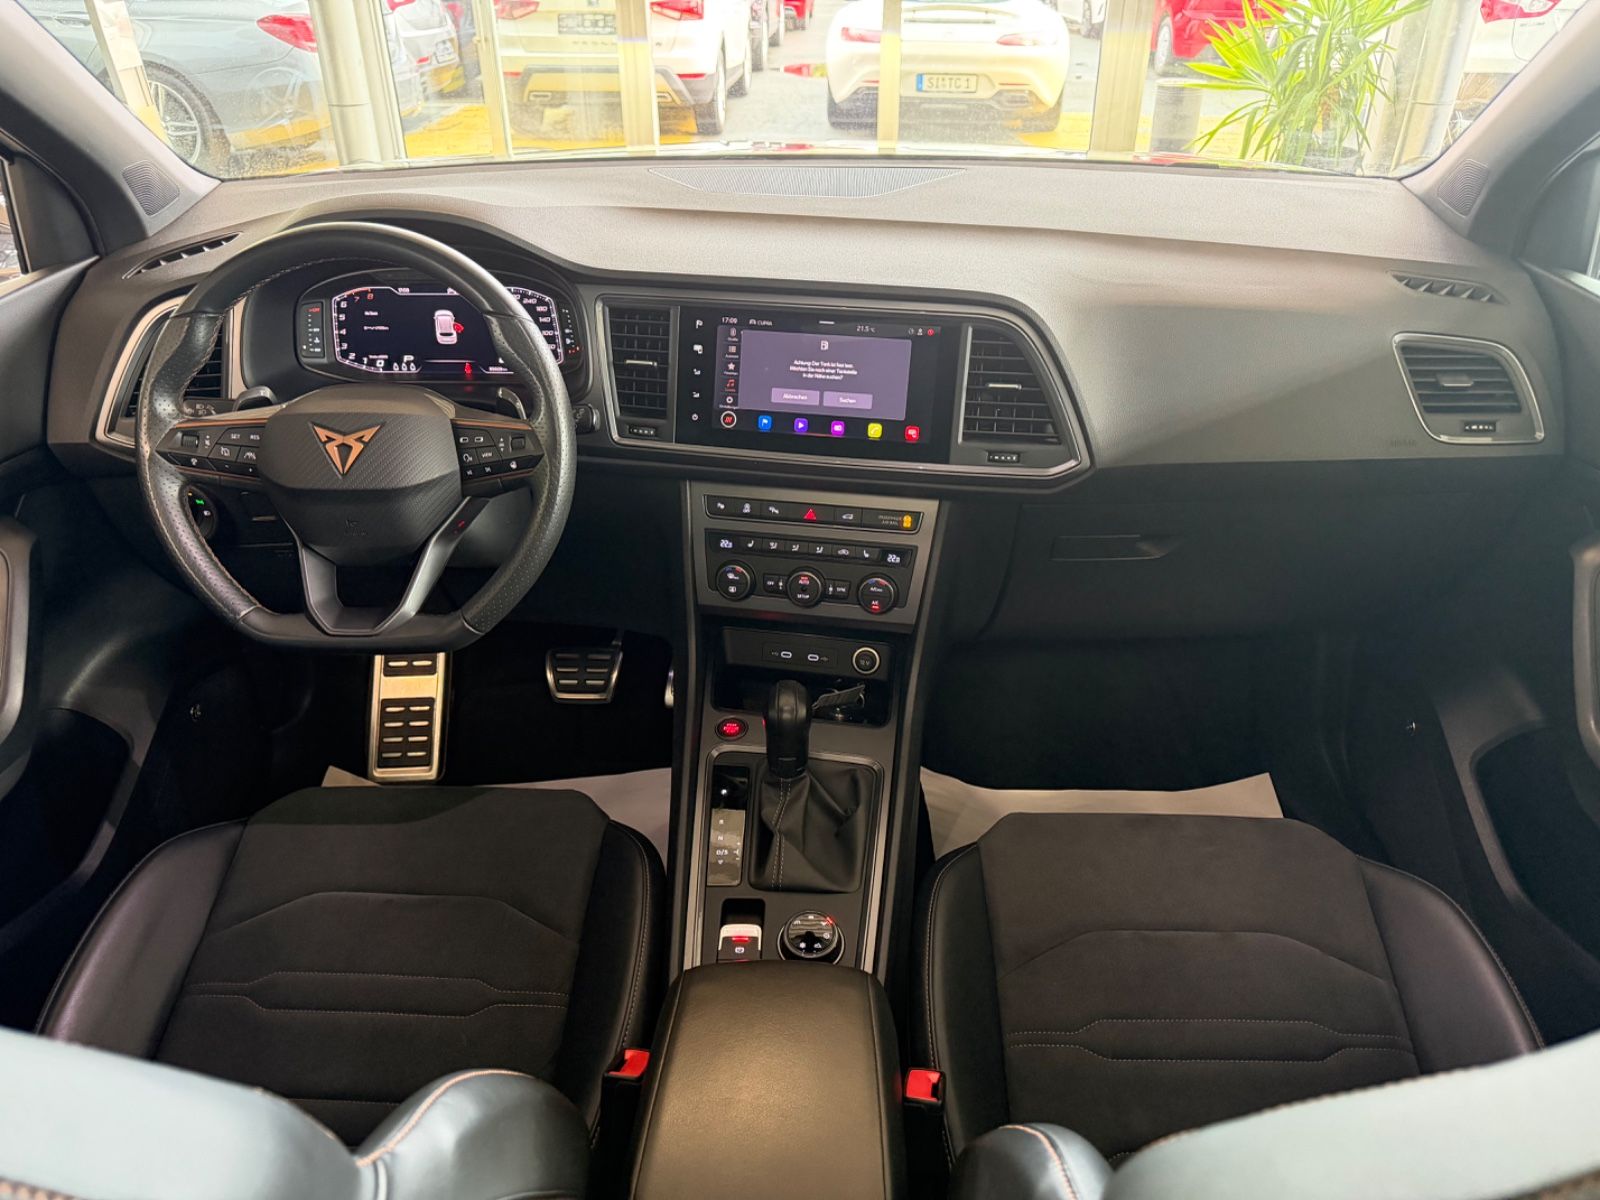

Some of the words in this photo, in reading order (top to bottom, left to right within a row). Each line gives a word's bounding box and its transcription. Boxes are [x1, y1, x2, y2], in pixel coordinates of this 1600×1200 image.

[927, 77, 939, 89] SI
[948, 77, 961, 89] TC
[349, 352, 356, 360] 2
